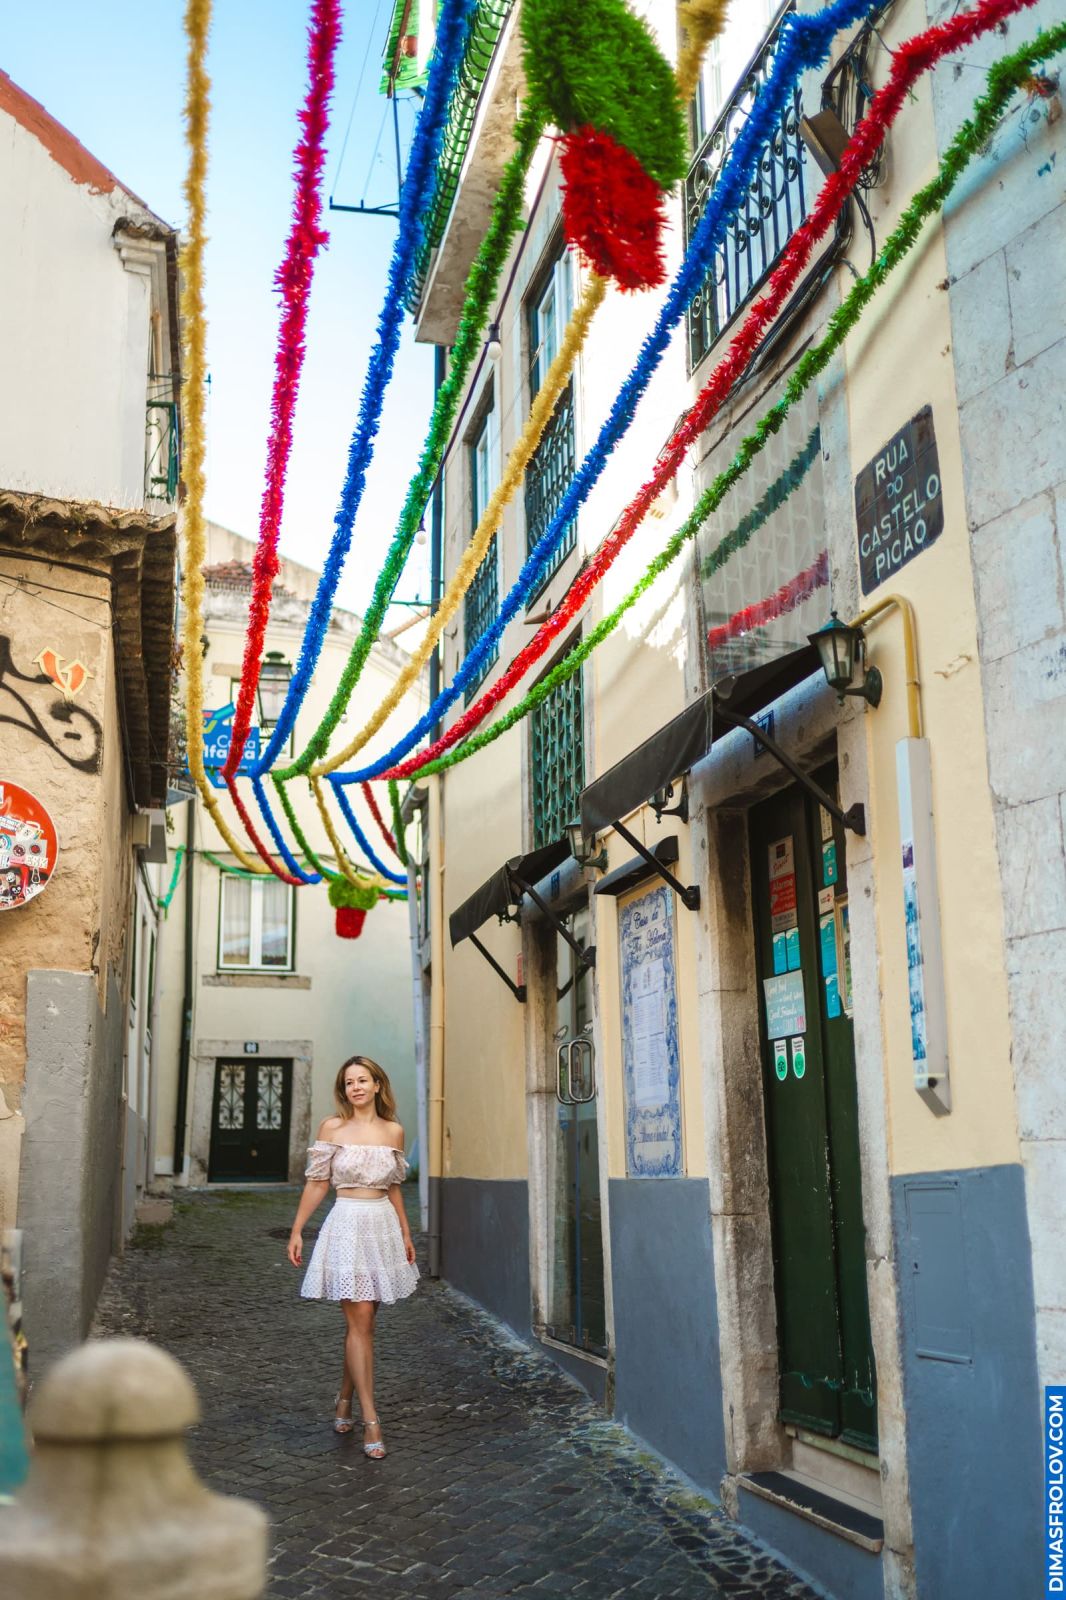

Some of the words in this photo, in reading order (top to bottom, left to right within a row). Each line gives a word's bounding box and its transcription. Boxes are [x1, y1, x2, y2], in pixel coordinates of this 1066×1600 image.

[875, 439, 908, 485] RUA
[886, 475, 903, 499] DO
[860, 473, 939, 558] CASTELO
[875, 518, 927, 580] PICÃO
[204, 743, 256, 760] lfaa
